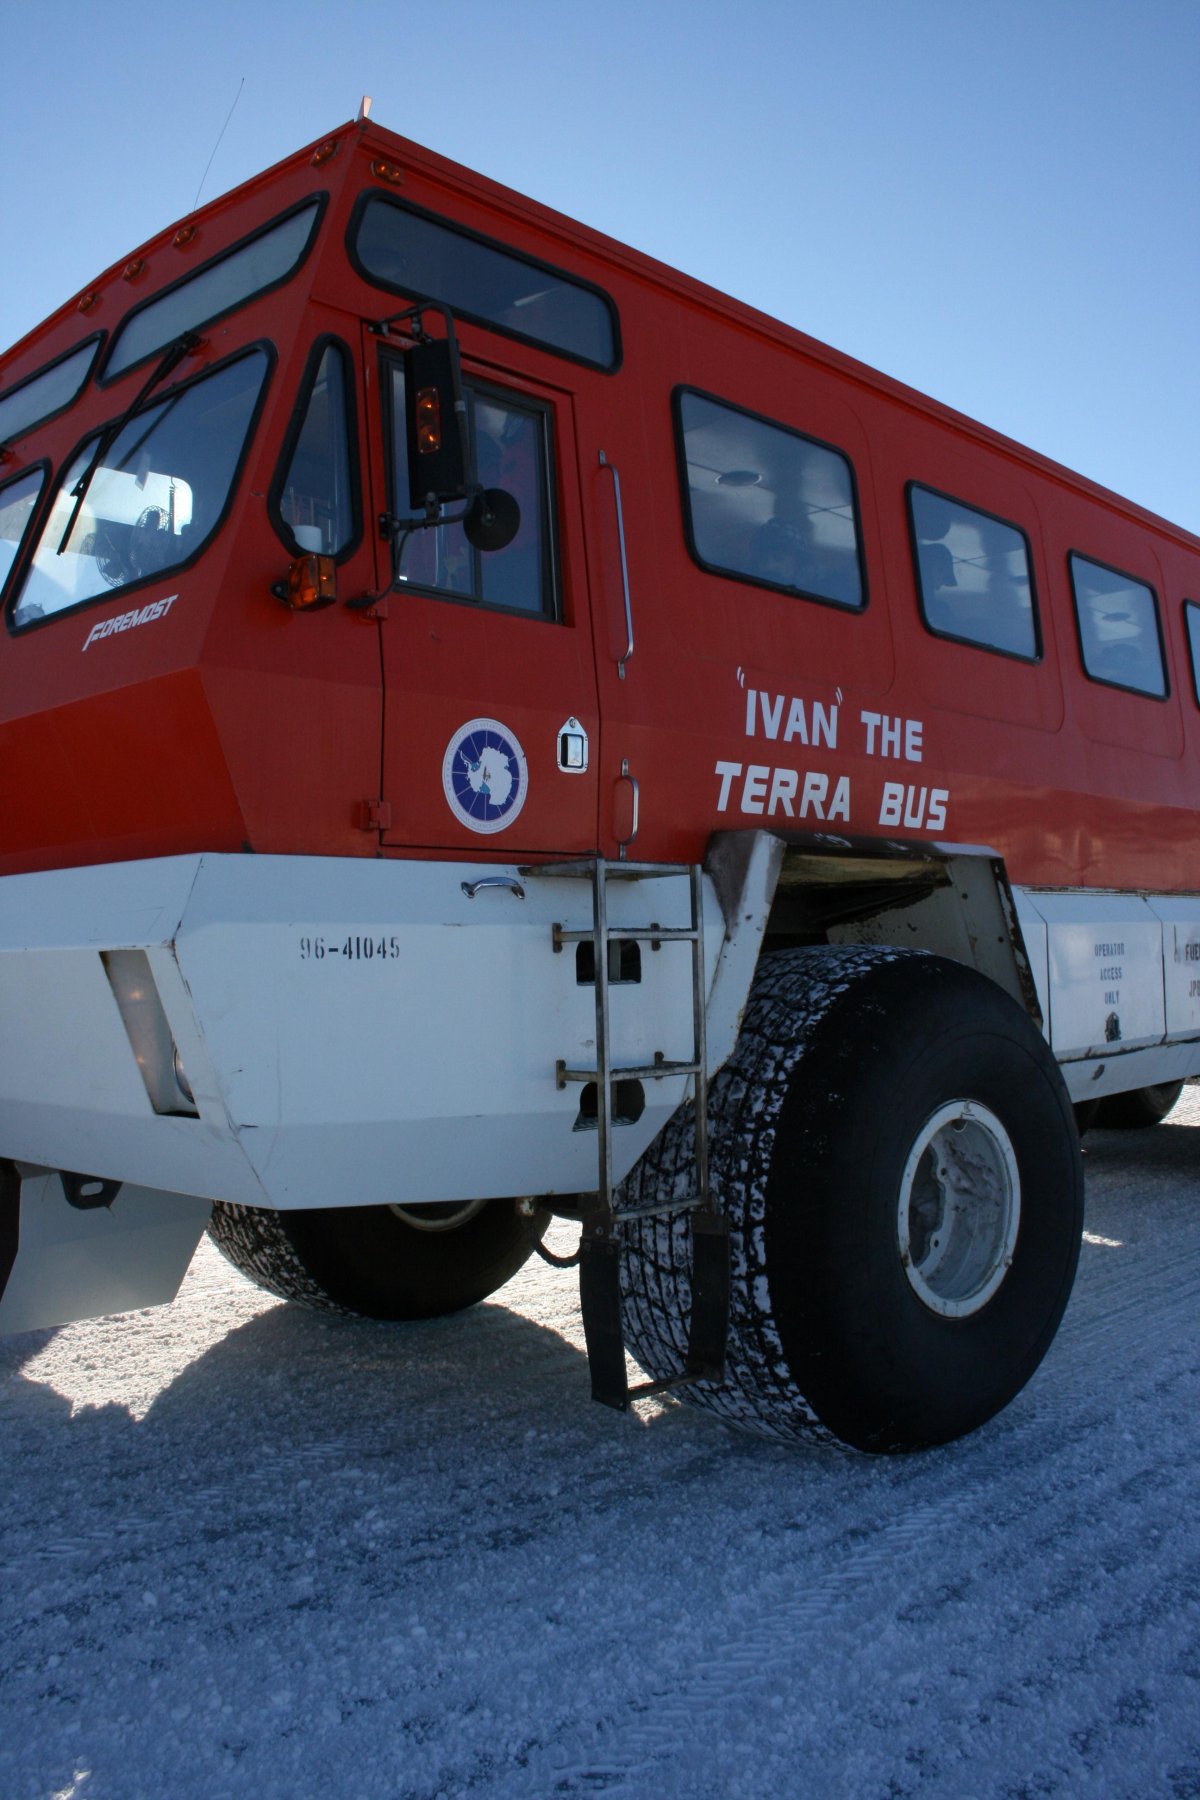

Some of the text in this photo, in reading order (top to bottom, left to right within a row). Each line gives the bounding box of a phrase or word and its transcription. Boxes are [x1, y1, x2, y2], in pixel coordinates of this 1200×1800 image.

[82, 594, 179, 652] FOREMOST
[860, 710, 923, 763] THE
[714, 760, 949, 831] TERRA BUS
[300, 936, 400, 960] 96-41045
[1100, 967, 1122, 981] ACCESS
[1104, 990, 1120, 1005] ONLY
